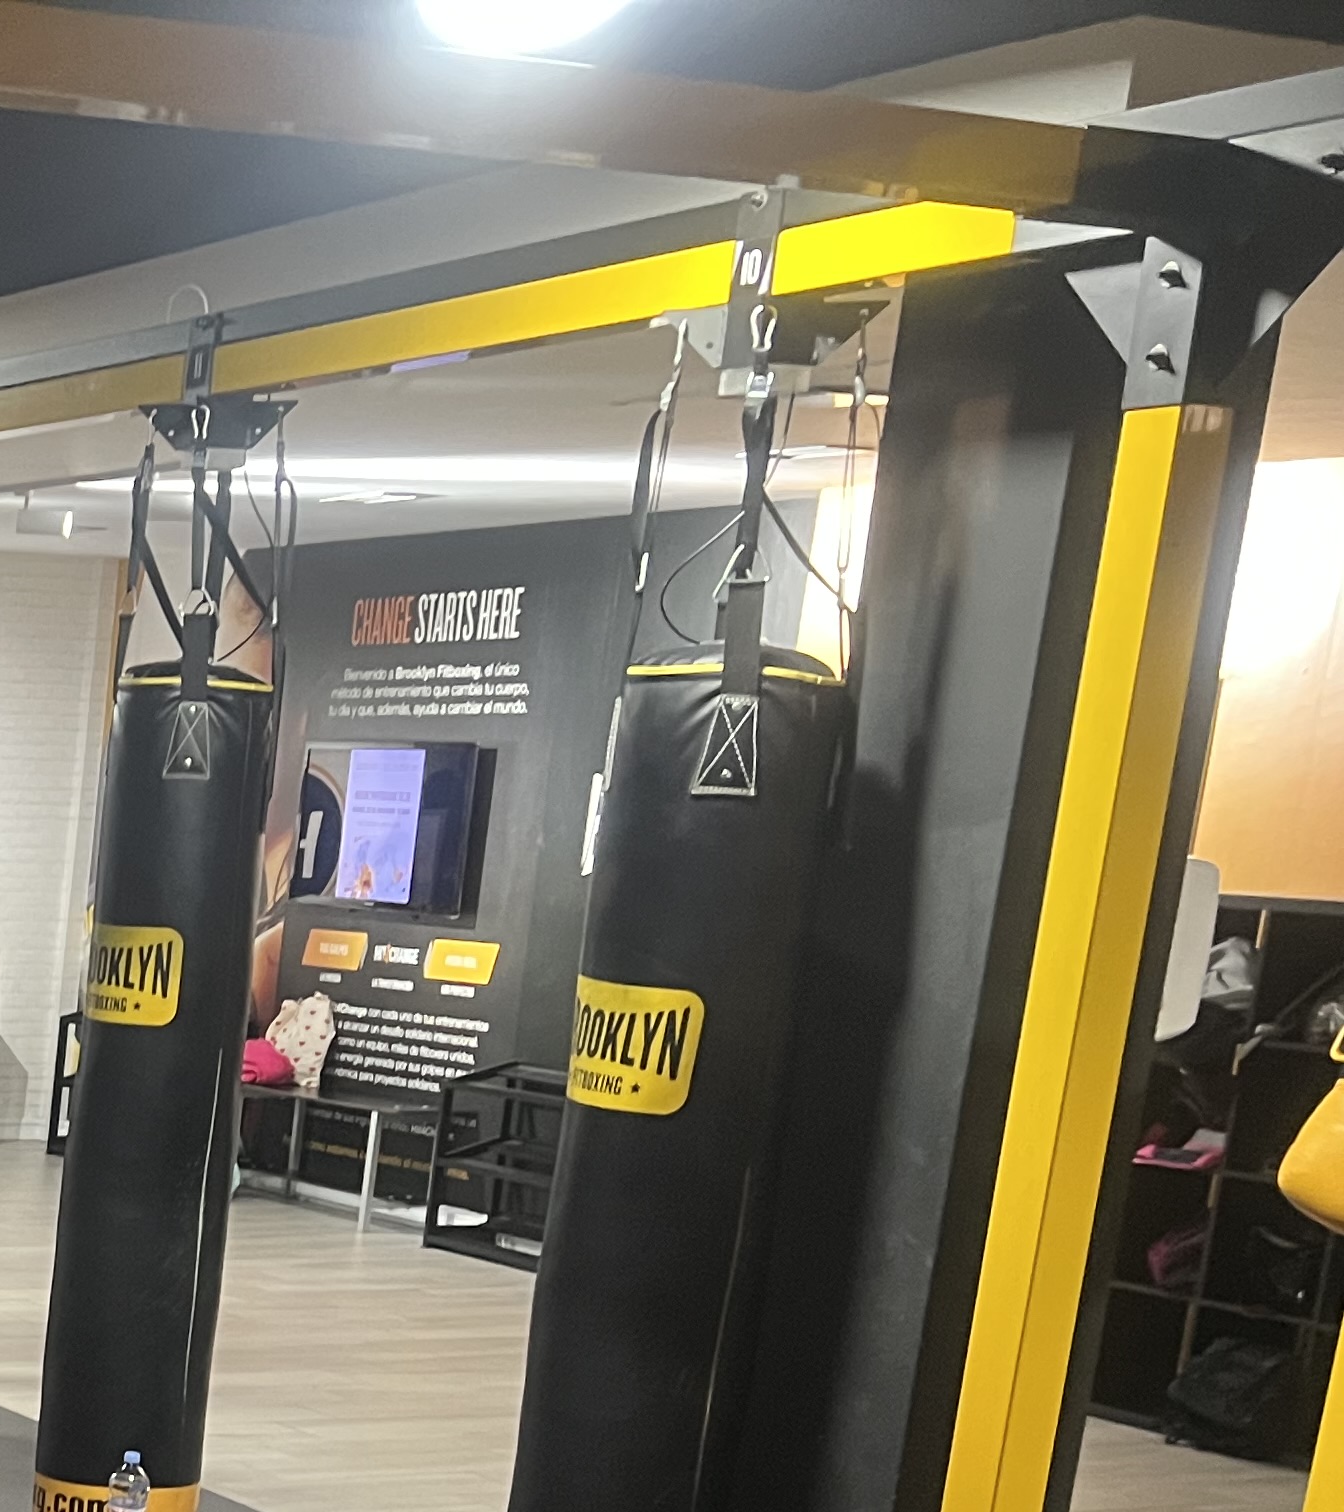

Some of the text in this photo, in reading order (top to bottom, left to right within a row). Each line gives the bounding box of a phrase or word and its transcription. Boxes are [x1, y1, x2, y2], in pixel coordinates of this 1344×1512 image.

[740, 248, 763, 286] 10
[351, 587, 525, 647] CHANGE STARTS HERE
